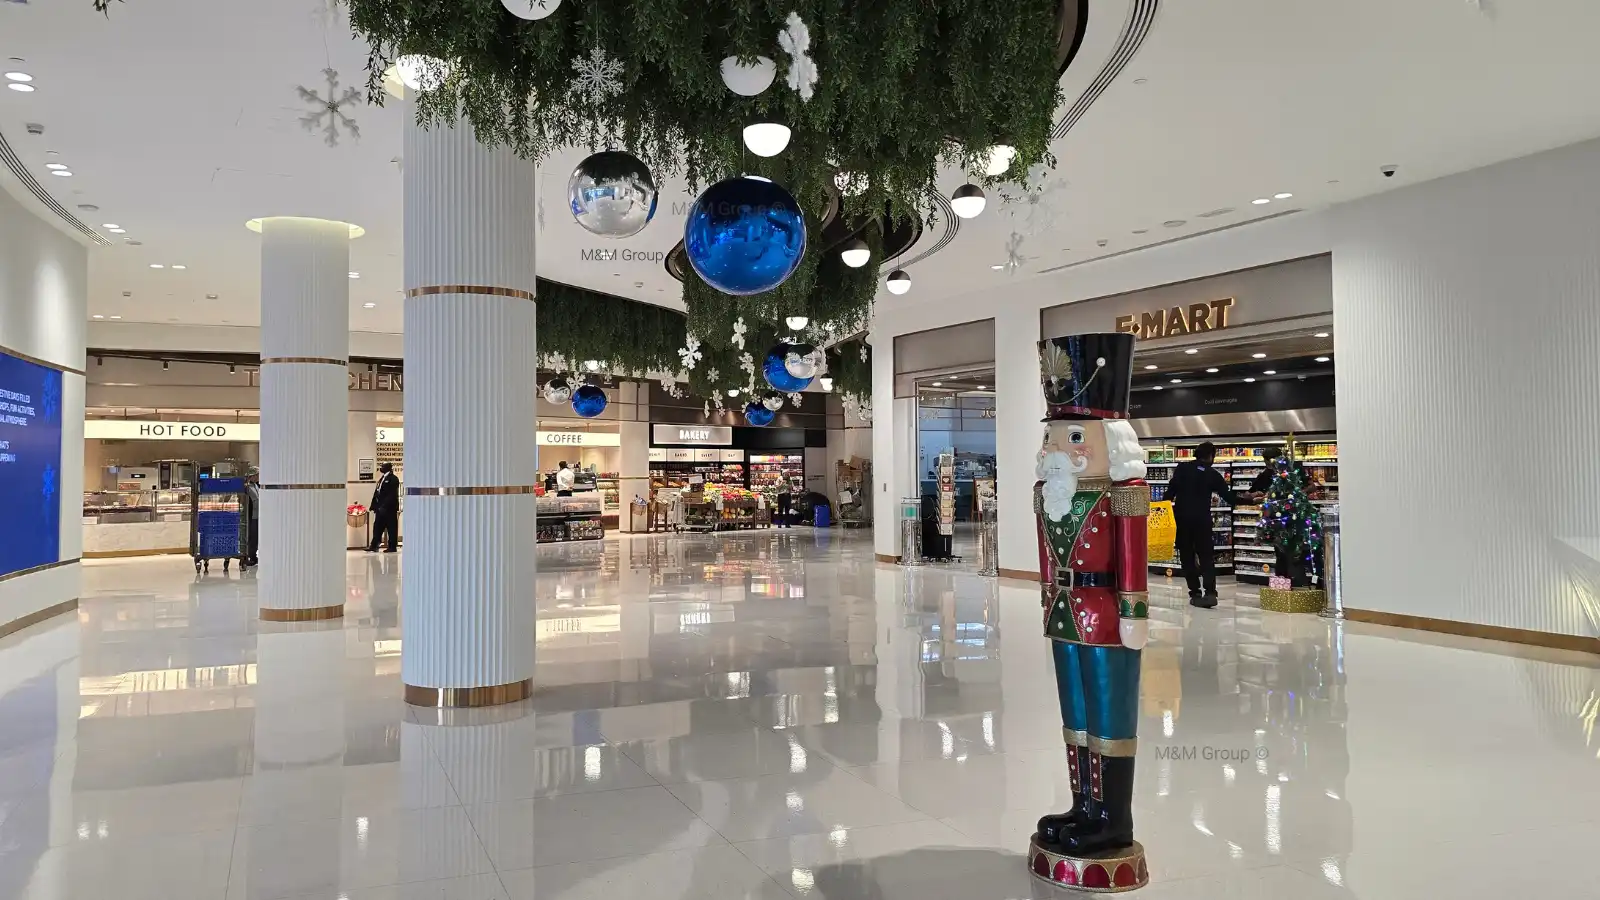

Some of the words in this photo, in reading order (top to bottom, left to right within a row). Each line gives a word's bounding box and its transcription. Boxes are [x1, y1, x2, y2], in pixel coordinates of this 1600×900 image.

[140, 425, 174, 436] HOT
[181, 425, 226, 437] FOOD
[680, 429, 710, 440] BAKERY
[546, 433, 582, 444] COFFEE
